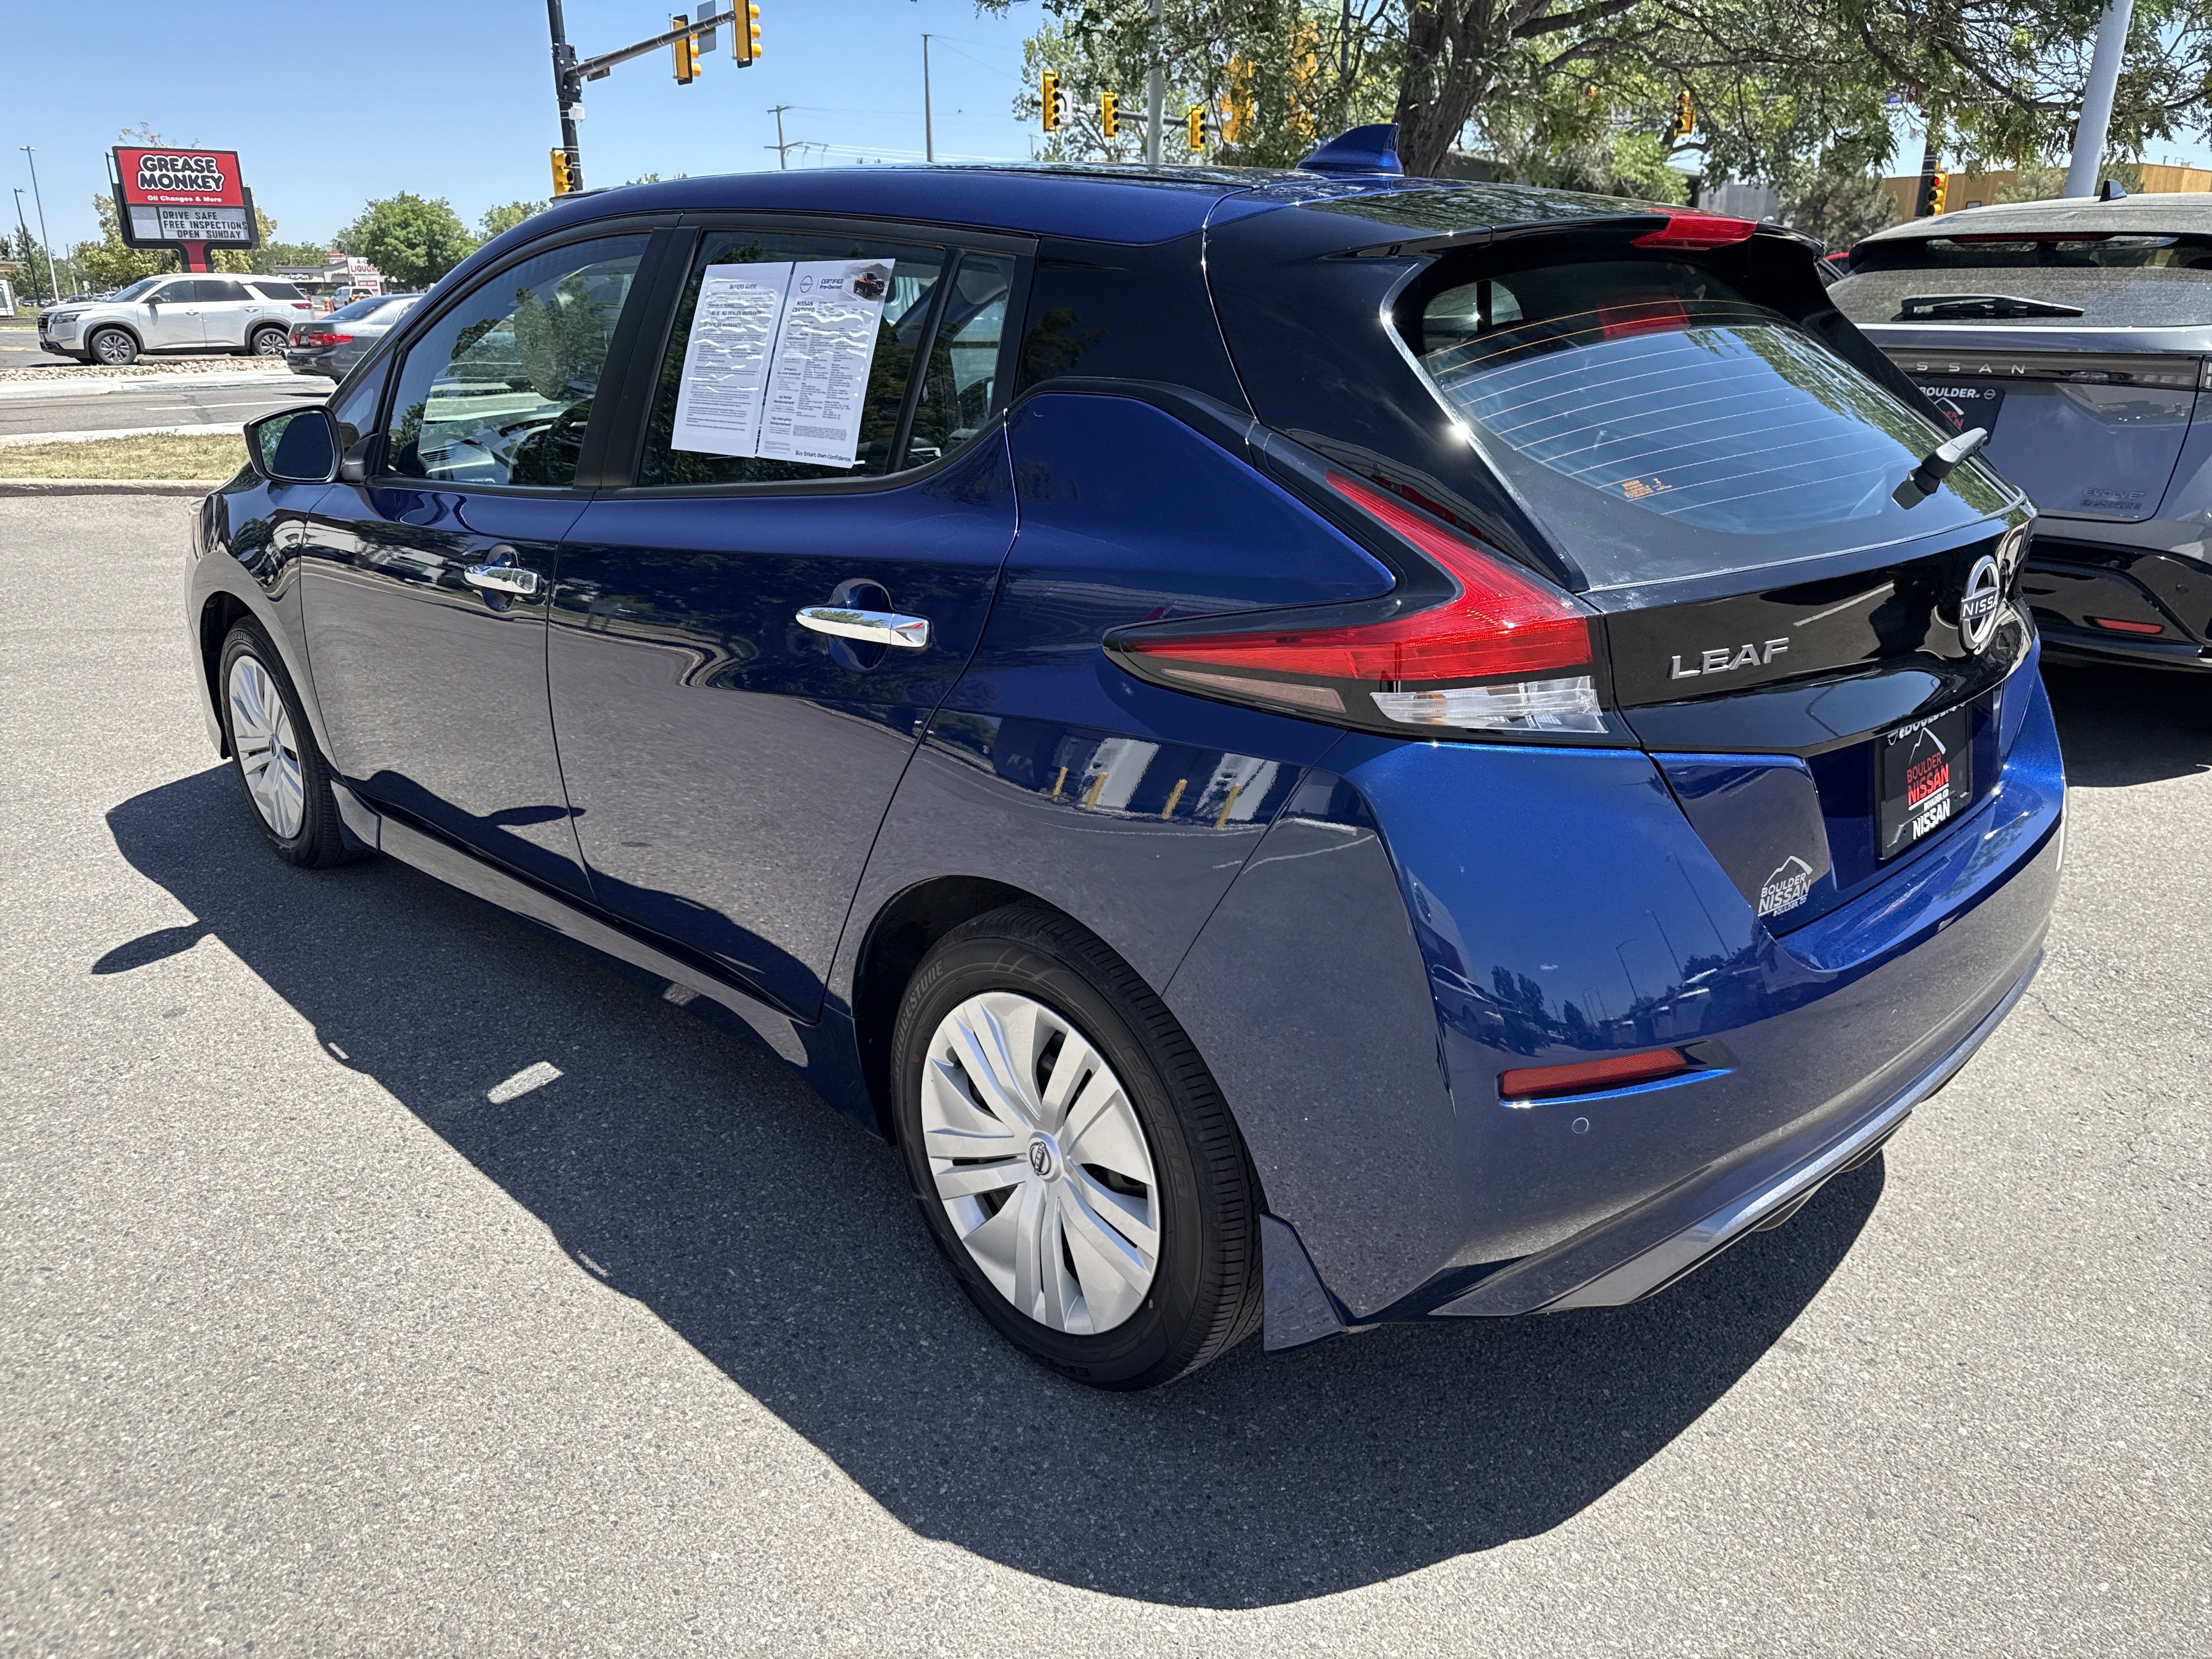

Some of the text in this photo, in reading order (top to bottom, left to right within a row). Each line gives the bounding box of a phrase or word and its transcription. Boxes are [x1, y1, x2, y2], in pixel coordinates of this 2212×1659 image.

[141, 155, 217, 174] GREASE
[139, 173, 223, 190] MONKEY
[162, 211, 217, 220] DRIVE SAFE
[163, 221, 247, 230] FREE INSPECTIONS
[177, 230, 241, 239] OPEN SUNDAY
[1894, 361, 2026, 374] SSAN
[827, 454, 852, 462] Confidence.
[1962, 594, 1997, 618] NISS
[1669, 636, 1790, 680] LEAF
[1906, 751, 1943, 783] BOULDER
[1908, 763, 1949, 806] NISSAN
[1912, 798, 1950, 840] NISSAN
[1758, 879, 1812, 914] NISSAN
[1760, 872, 1807, 898] BOULDER
[1124, 1046, 1190, 1199] ECOPIA
